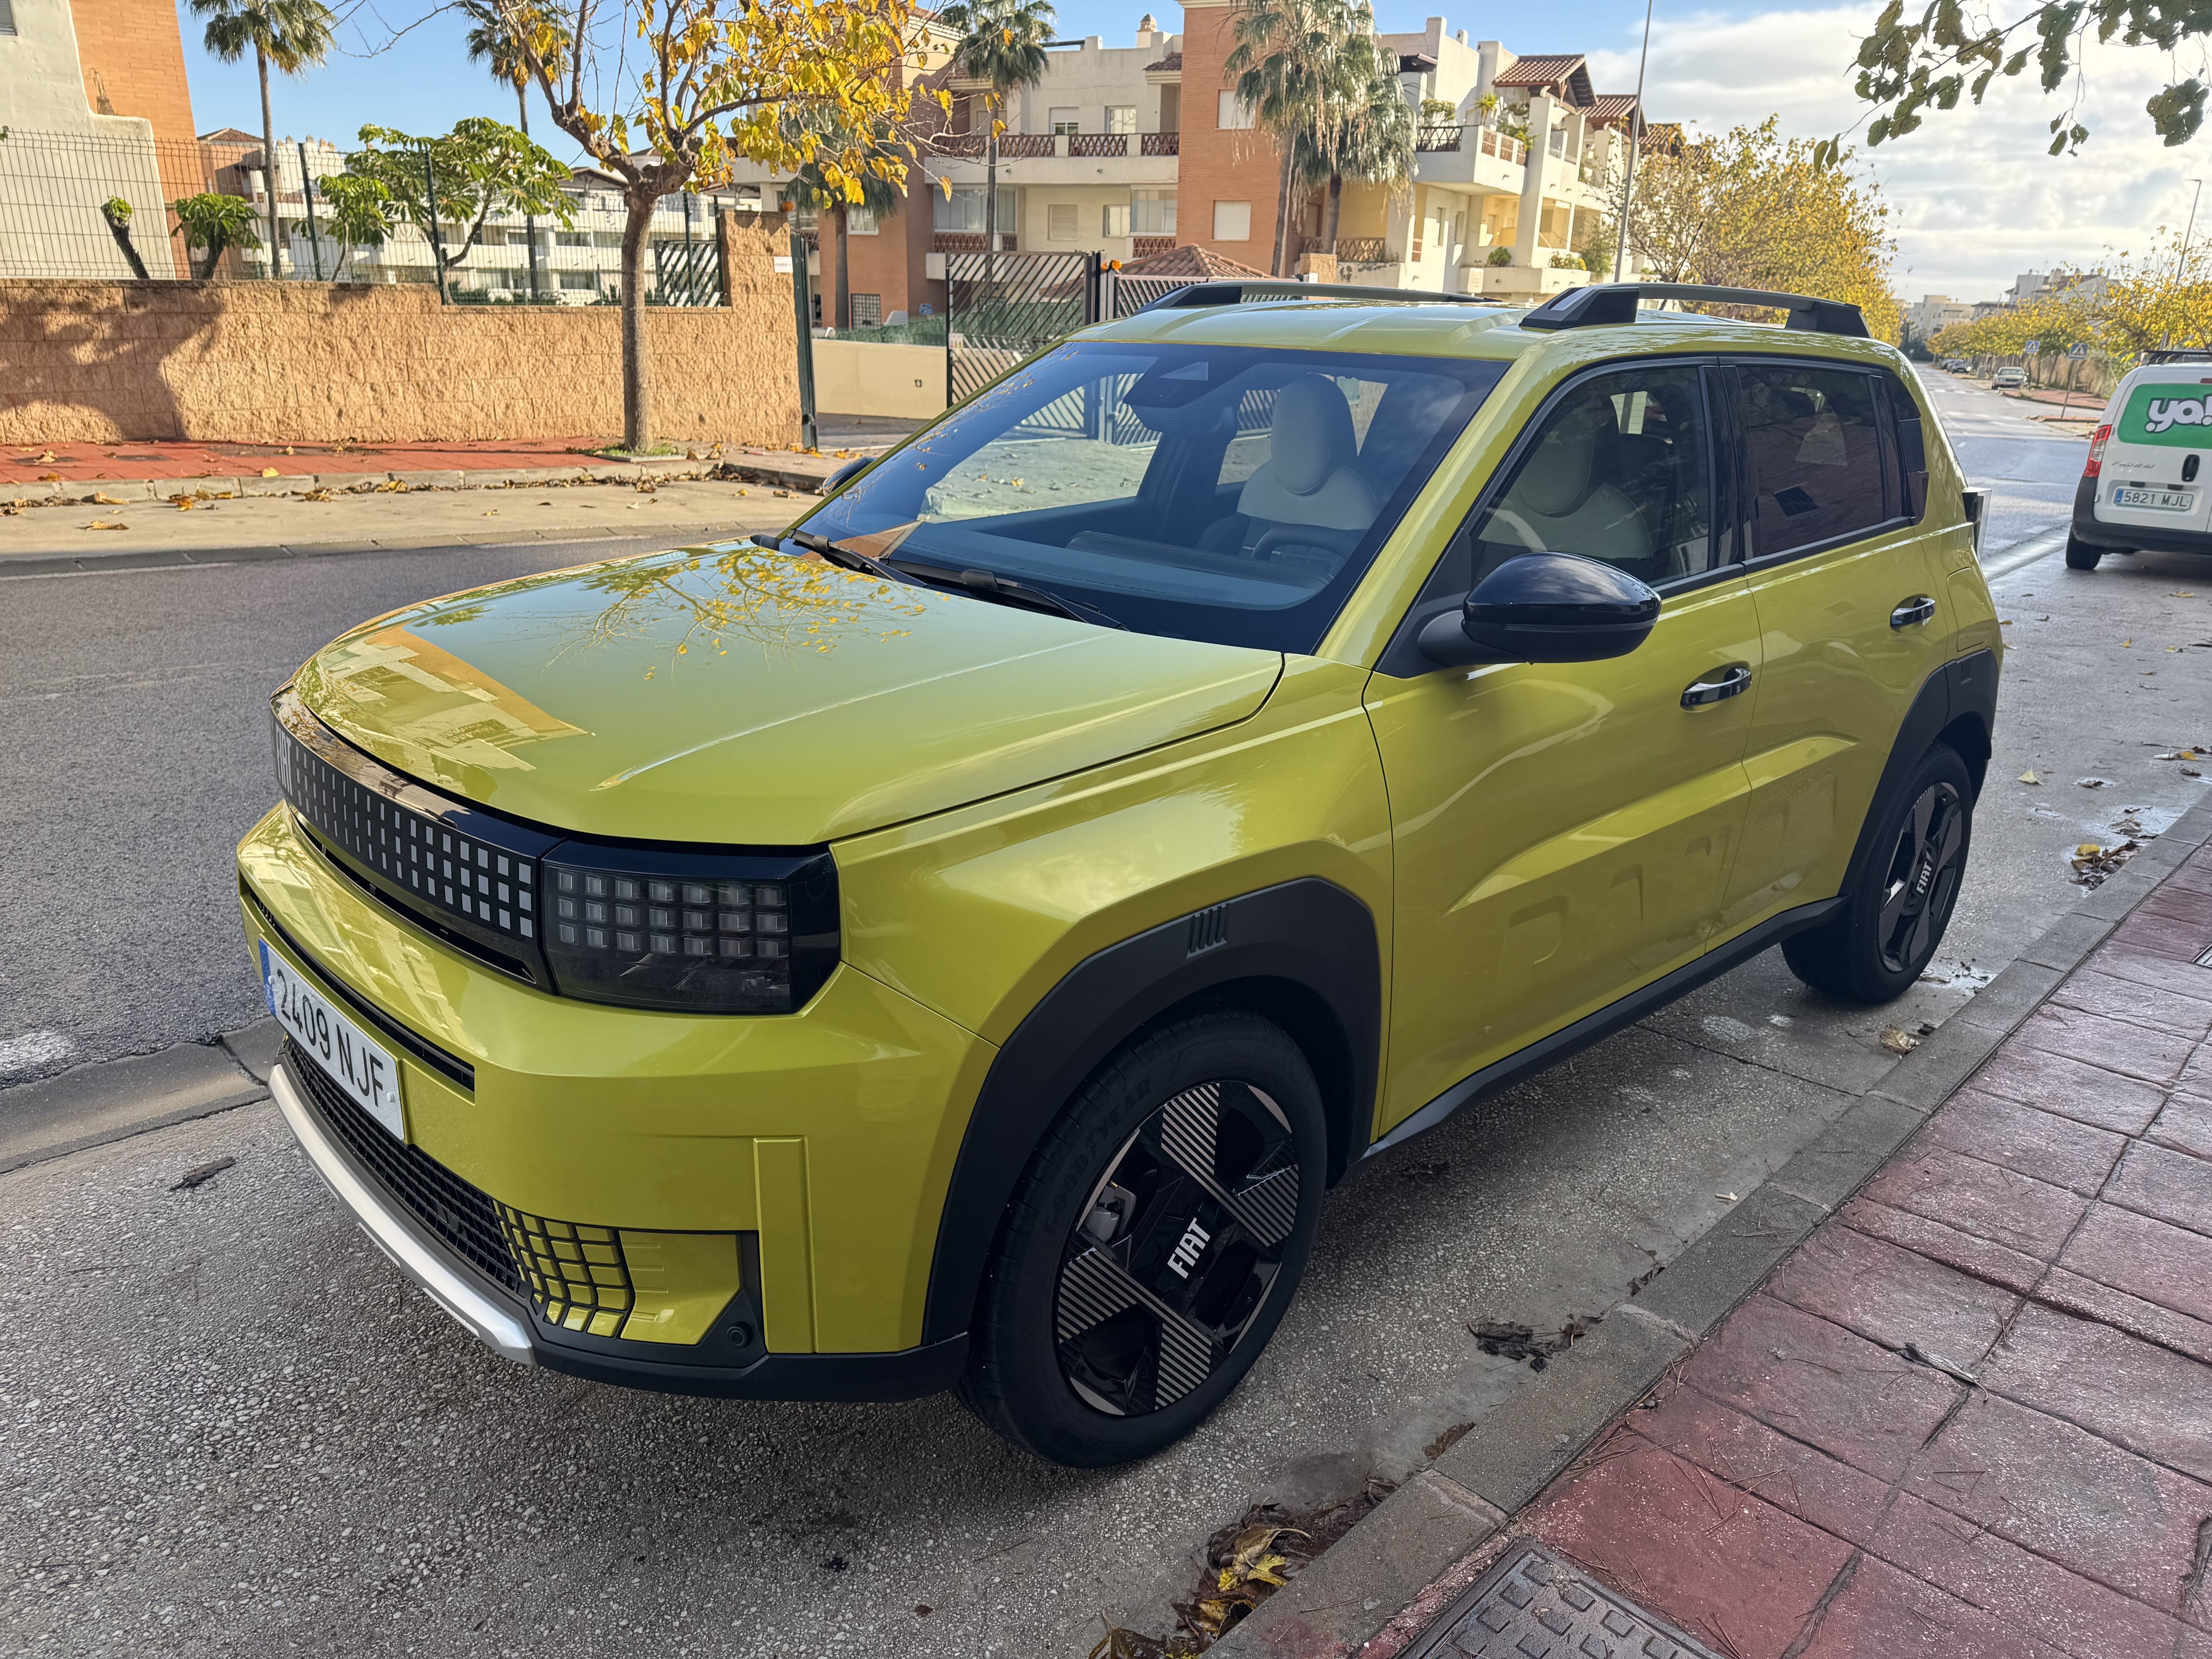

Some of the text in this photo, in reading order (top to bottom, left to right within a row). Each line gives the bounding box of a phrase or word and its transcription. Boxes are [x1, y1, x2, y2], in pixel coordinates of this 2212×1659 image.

[2124, 491, 2155, 504] 5821
[2161, 494, 2187, 507] MJL
[276, 722, 292, 797] FIAT
[1916, 861, 1932, 895] FIAT
[277, 969, 383, 1108] 2409 NJF
[1167, 1217, 1211, 1279] FIAT
